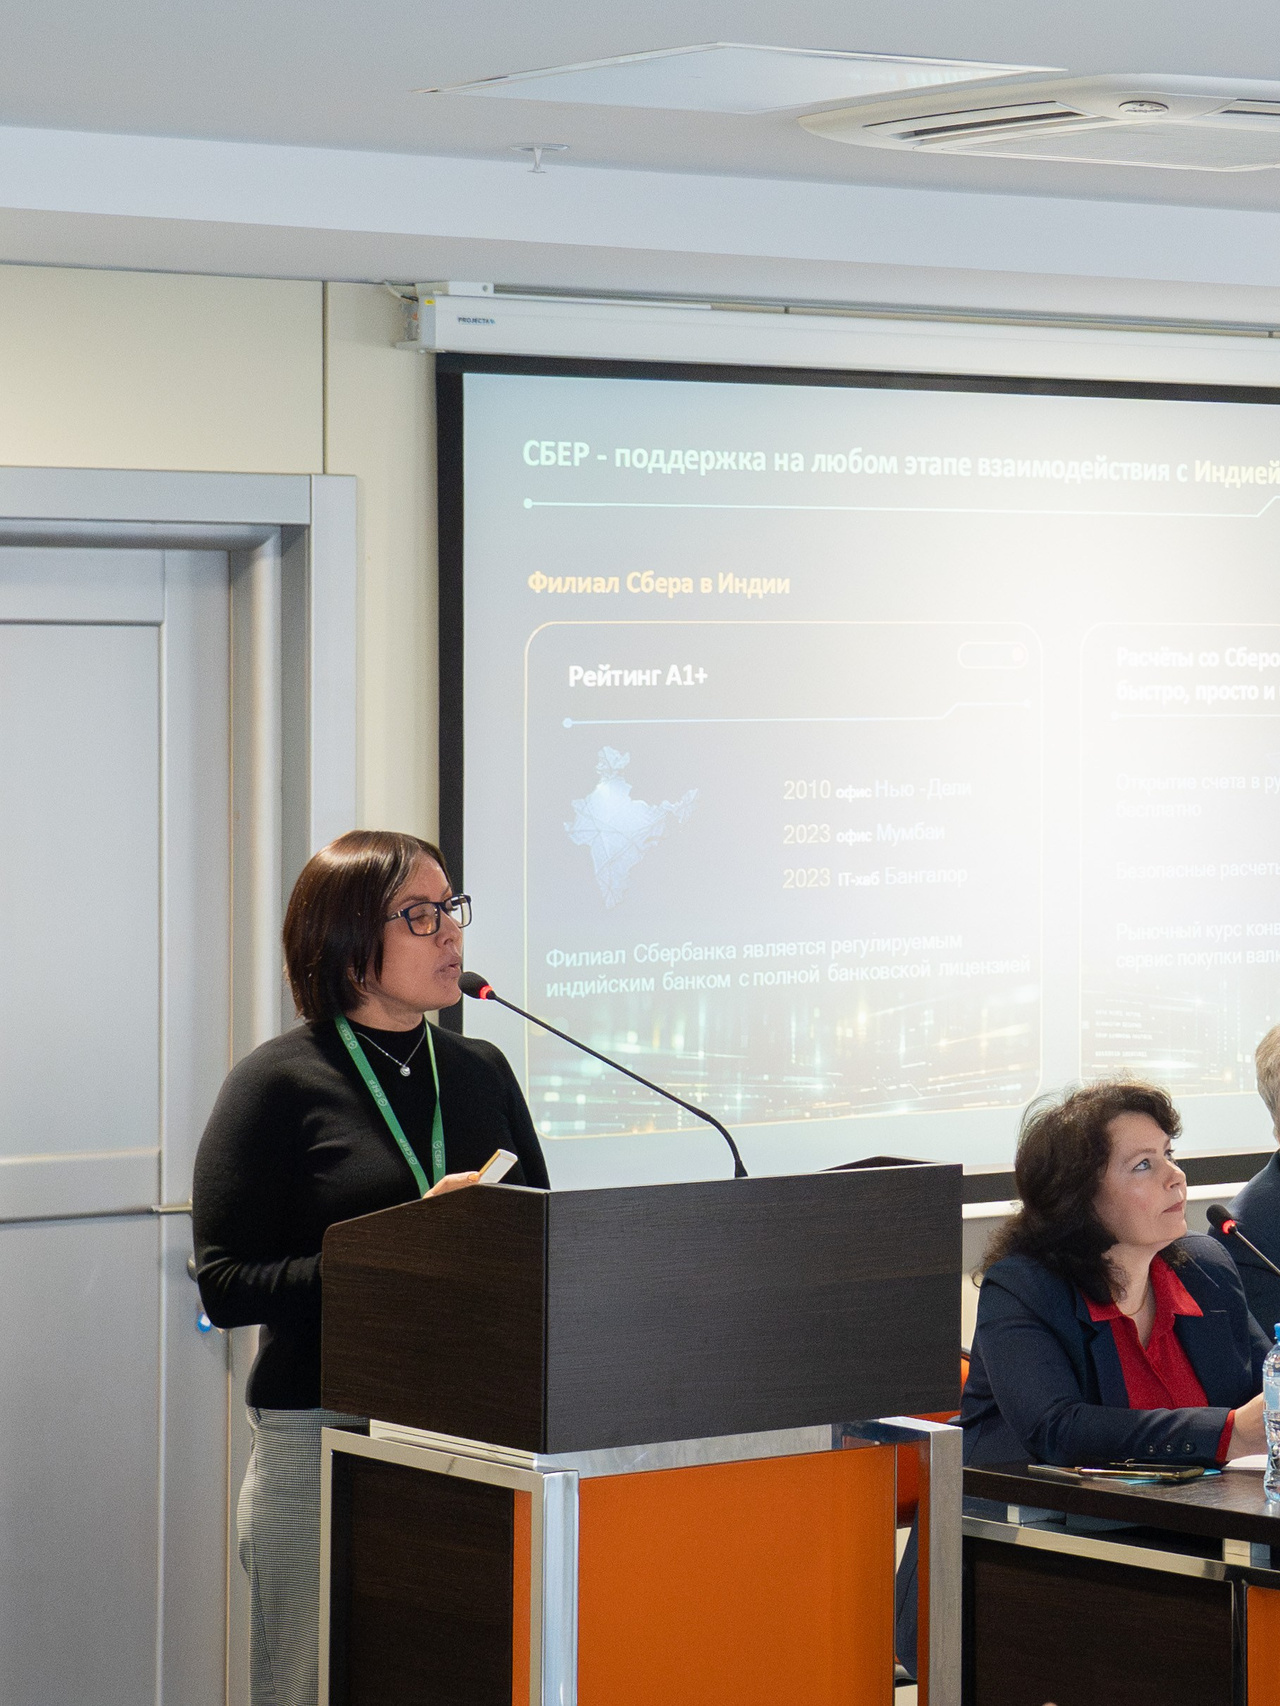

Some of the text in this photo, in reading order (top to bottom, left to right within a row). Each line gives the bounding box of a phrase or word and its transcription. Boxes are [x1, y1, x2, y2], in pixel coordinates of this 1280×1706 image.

[522, 439, 590, 467] СБЕР
[615, 448, 766, 476] поддержка
[774, 451, 804, 472] на
[811, 447, 898, 474] любом
[905, 455, 972, 477] этапе
[978, 454, 1170, 484] взаимодействия
[1176, 463, 1188, 483] с
[527, 570, 791, 599] Филиал Сбера в Индии
[1116, 647, 1193, 667] Расчёты
[1198, 650, 1220, 668] со
[568, 663, 662, 688] Рейтинг
[1195, 683, 1258, 705] просто
[1263, 684, 1275, 700] и
[783, 780, 831, 800] 2010
[835, 785, 872, 802] офис
[874, 779, 915, 798] Нью
[1201, 776, 1246, 789] счета
[1251, 776, 1260, 789] в
[782, 824, 831, 845] 2023
[836, 829, 873, 846] офис
[782, 867, 831, 889] 2023
[884, 866, 968, 888] Бангалор
[1116, 921, 1202, 941] Рыночный
[1206, 923, 1242, 943] курс
[545, 934, 963, 968] Филиал Сбербанка является регулируемым
[1116, 952, 1175, 973] сервис
[1177, 949, 1242, 971] покупки
[545, 953, 1030, 999] индийским банком с полной банковской лицензией
